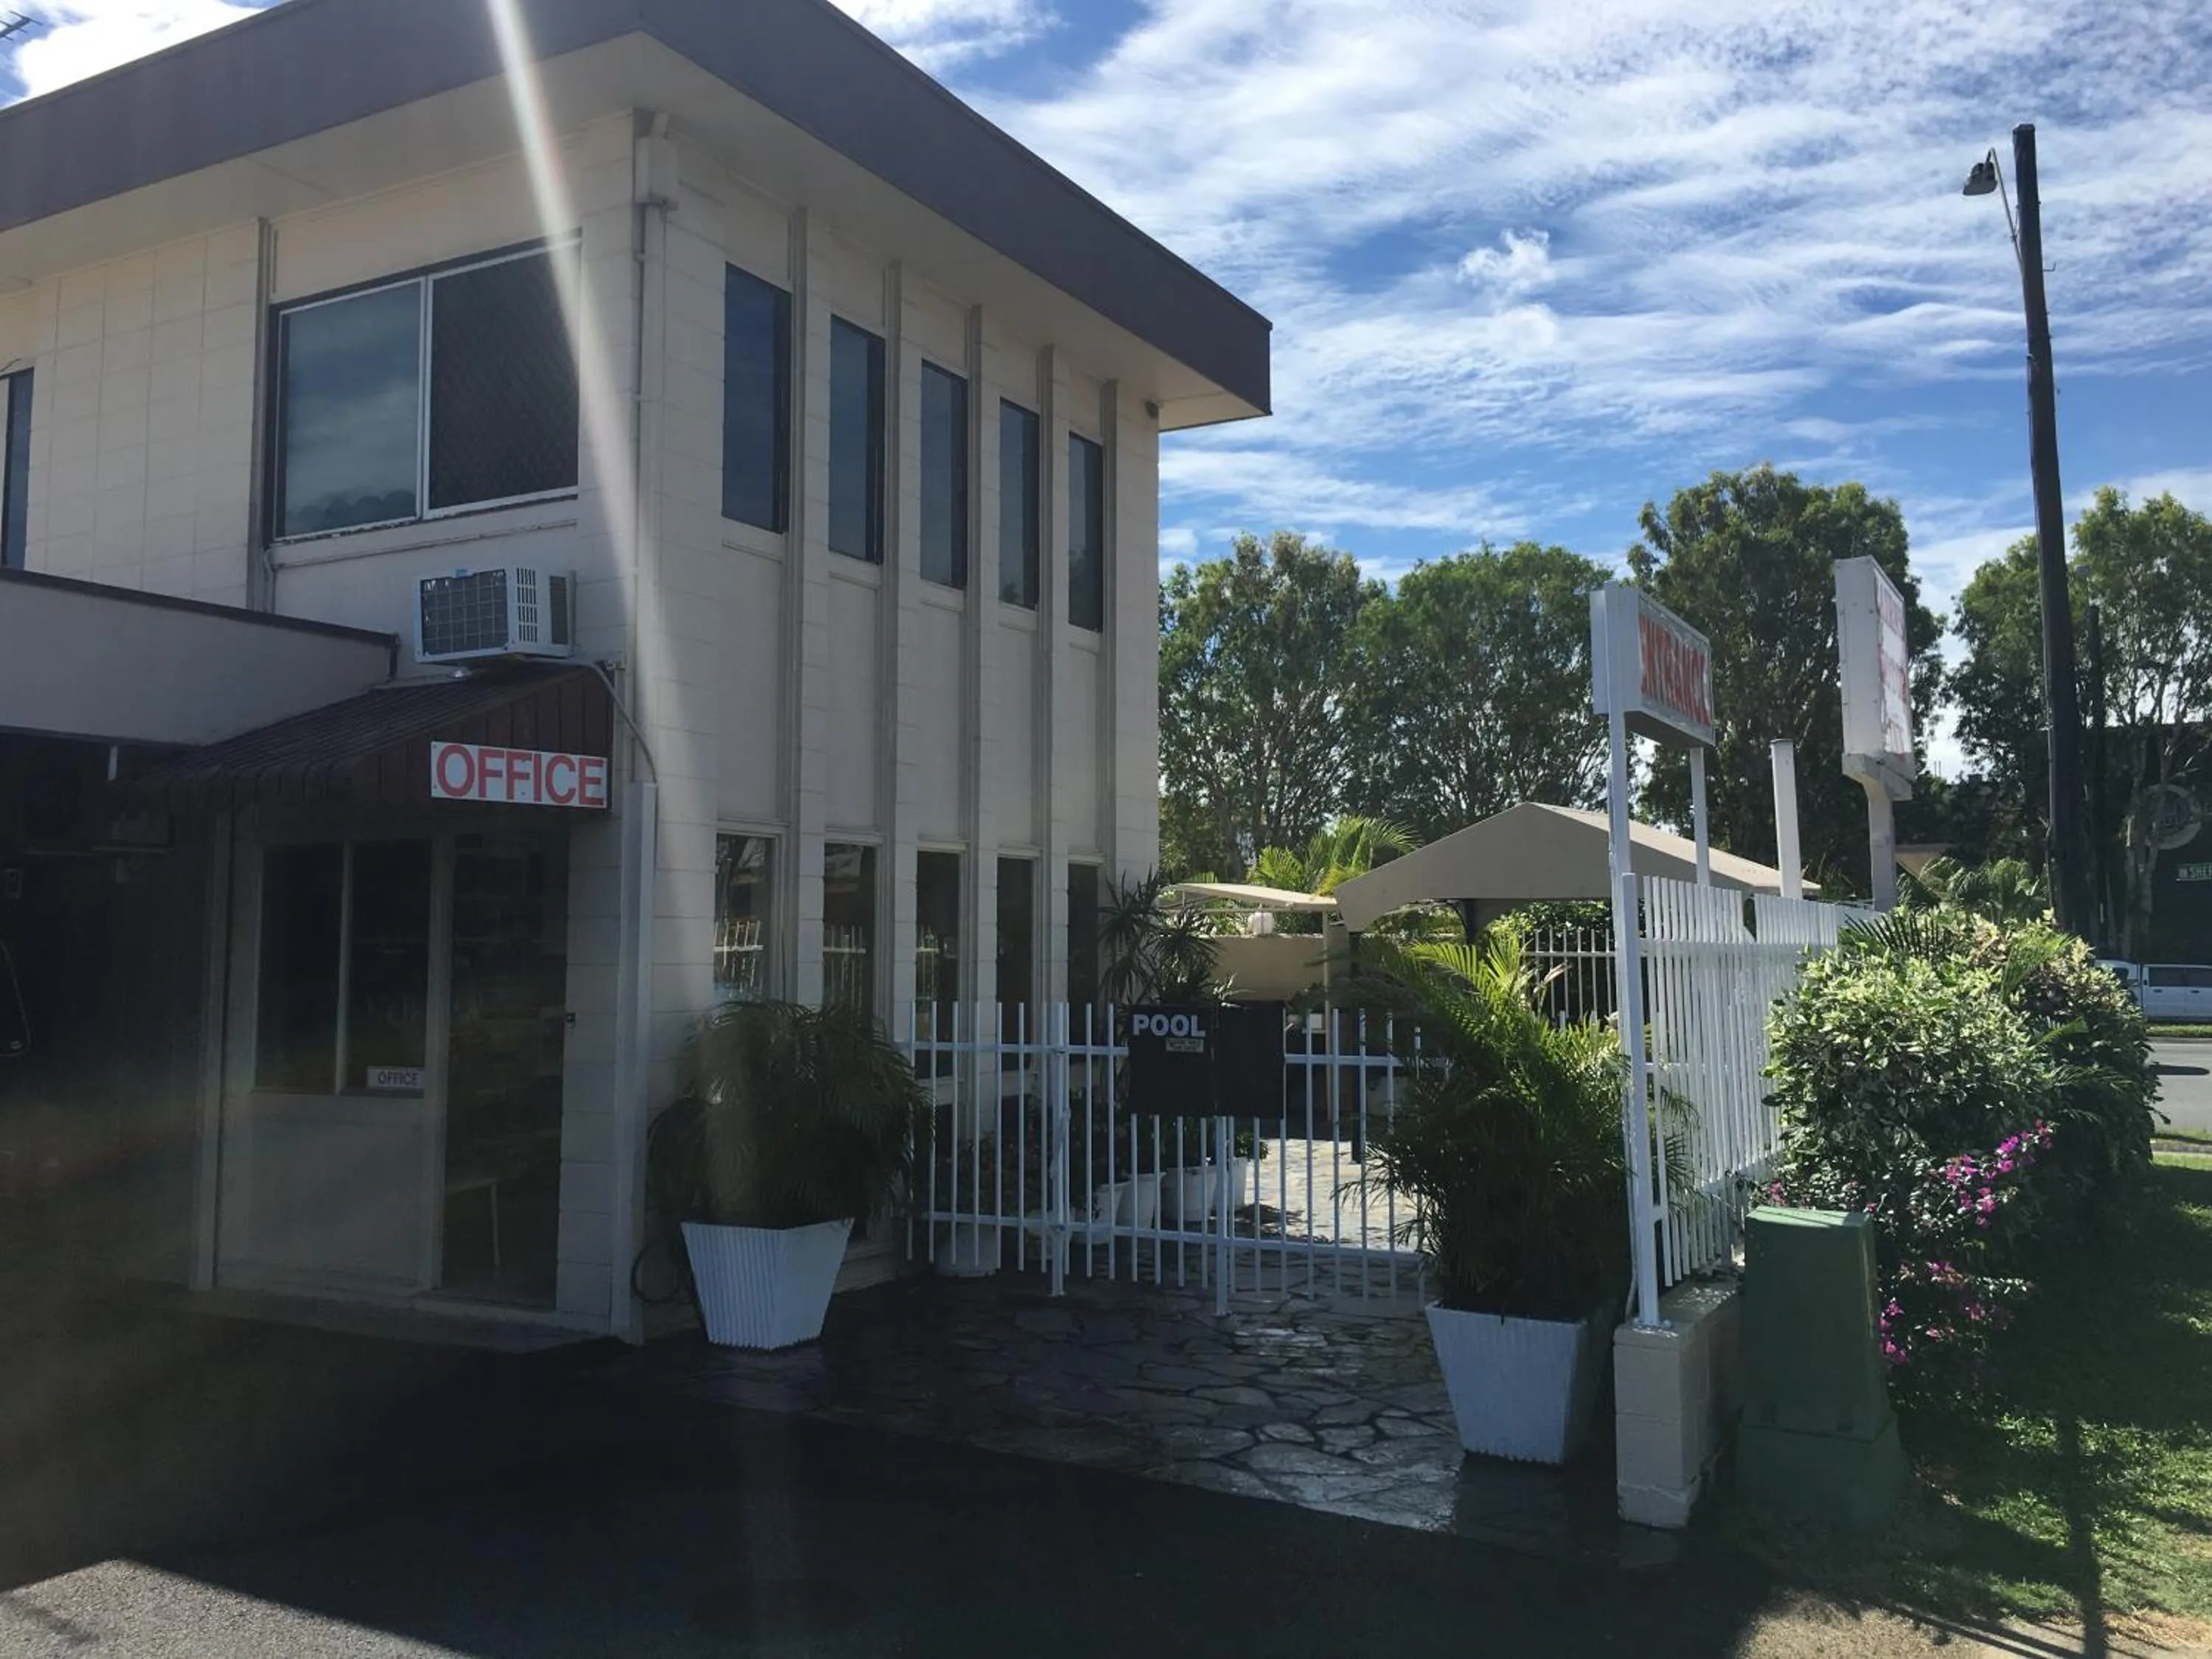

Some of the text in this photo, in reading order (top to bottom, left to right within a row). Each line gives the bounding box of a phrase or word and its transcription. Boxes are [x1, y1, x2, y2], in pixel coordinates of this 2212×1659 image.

[437, 744, 604, 806] OFFICE
[1133, 1014, 1206, 1037] POOL
[378, 1071, 420, 1086] OFFICE
